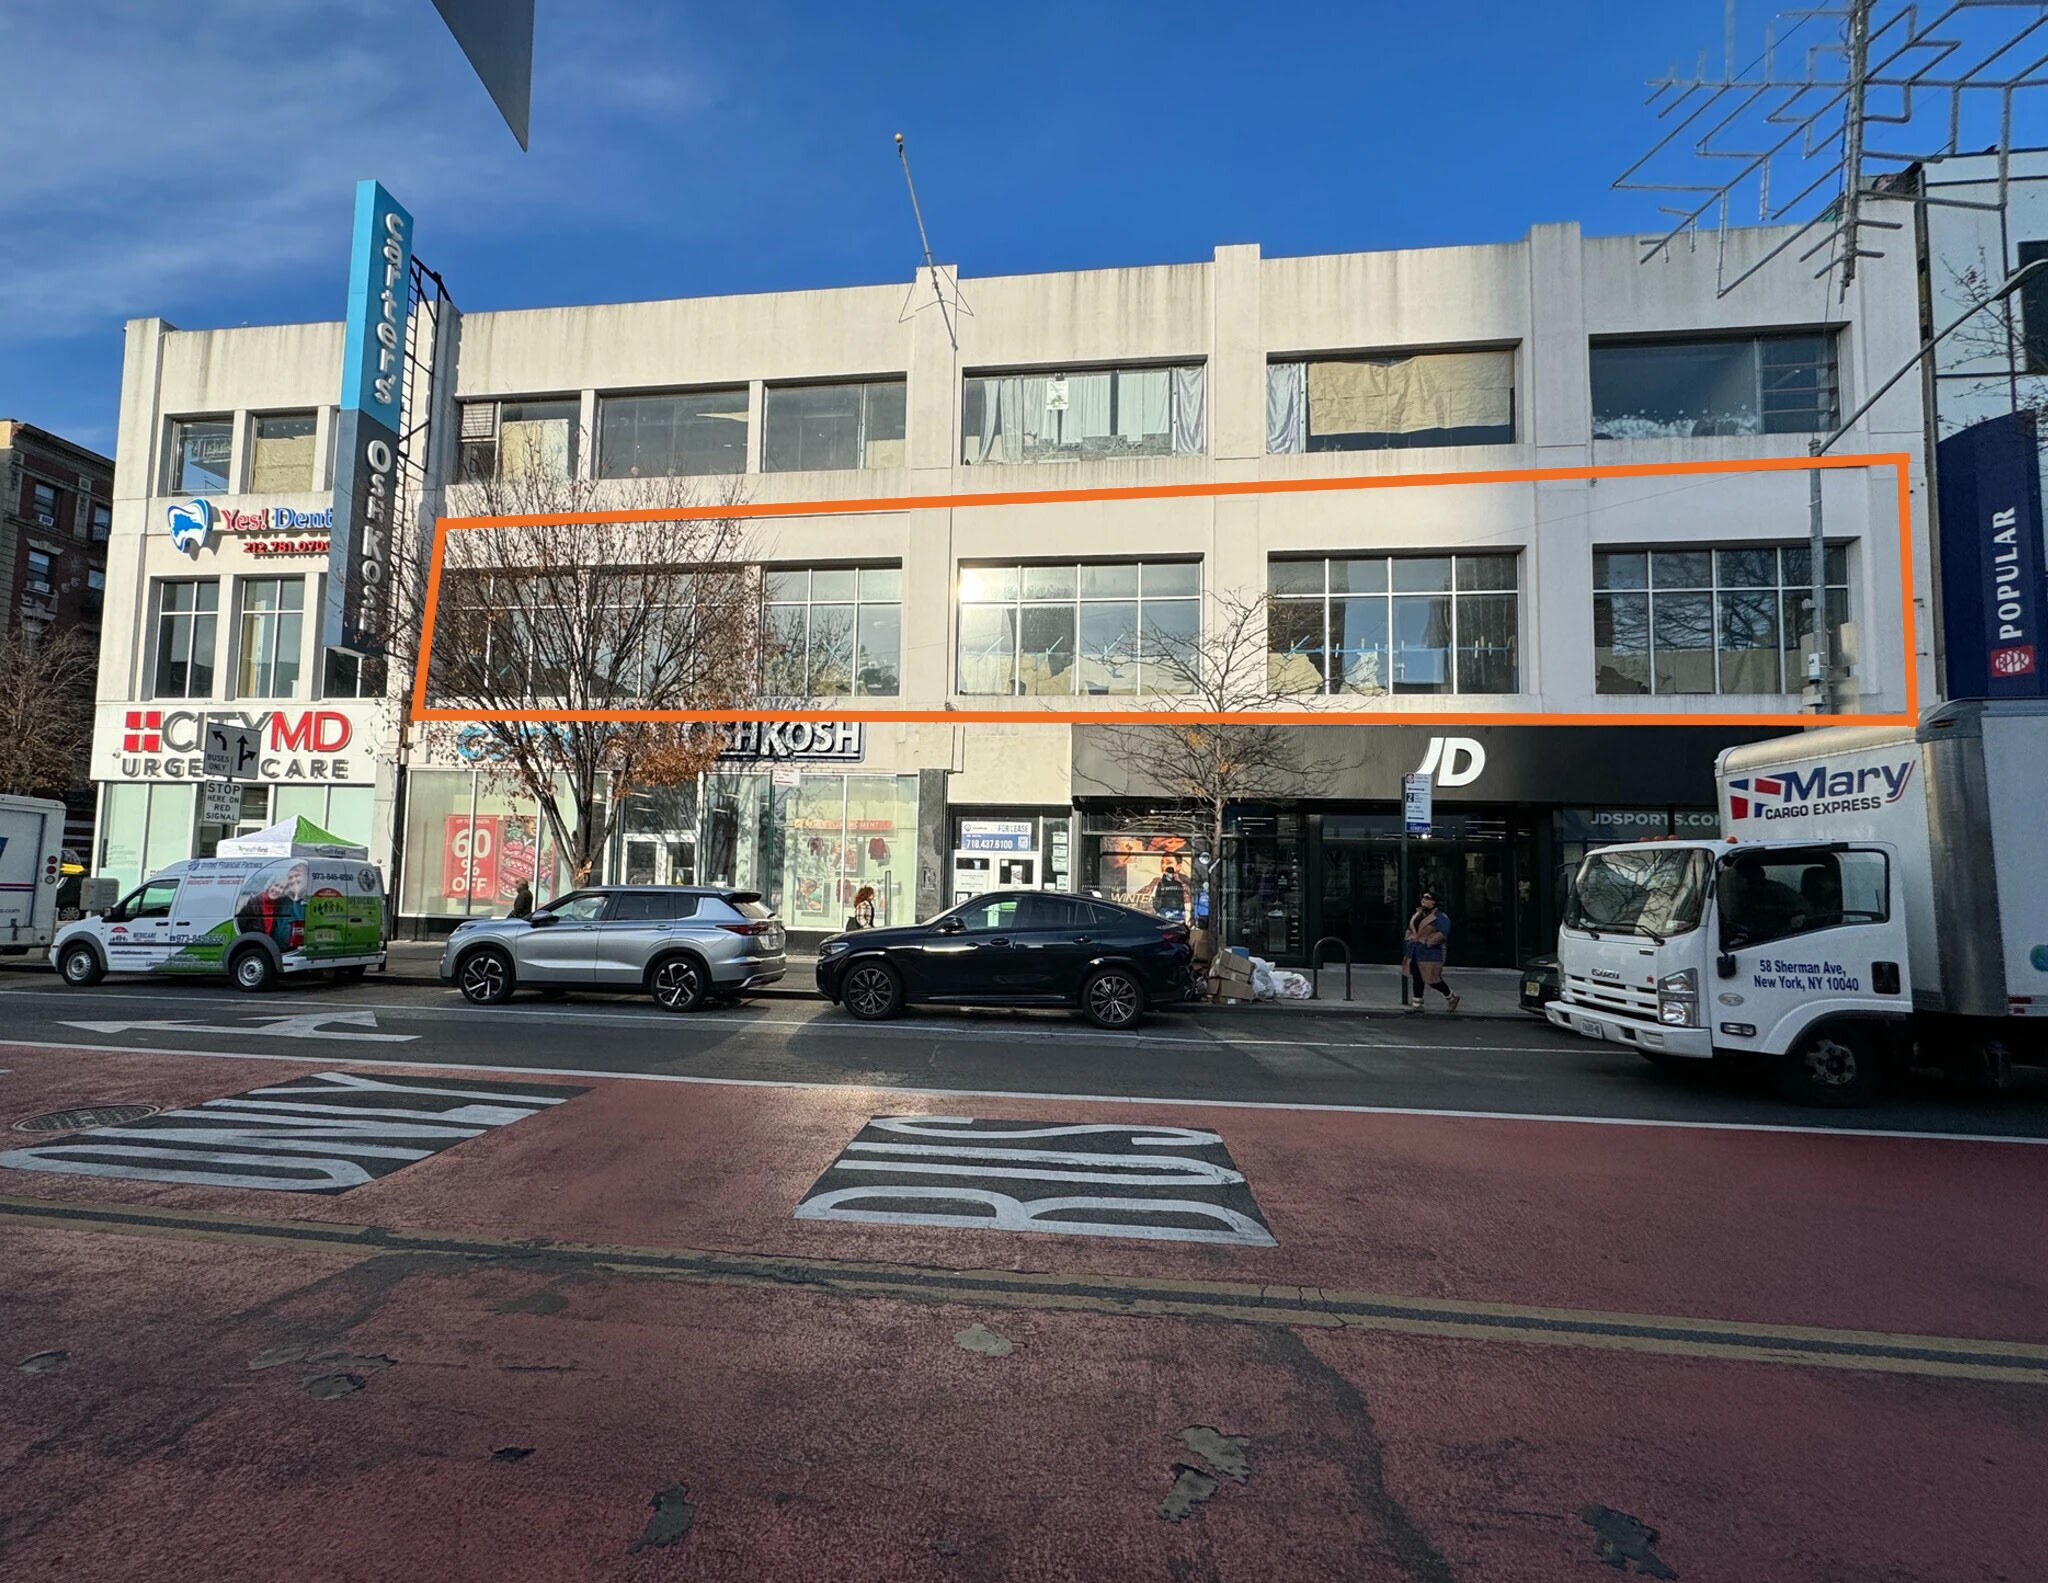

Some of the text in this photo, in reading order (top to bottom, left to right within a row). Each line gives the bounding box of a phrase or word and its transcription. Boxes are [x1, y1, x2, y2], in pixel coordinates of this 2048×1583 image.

[220, 508, 333, 531] Yes! Dent
[1992, 507, 2023, 640] POPULAR
[122, 758, 349, 779] URGE CARE
[207, 754, 229, 763] BUSES
[209, 763, 227, 771] ONLY
[1415, 737, 1486, 787] JD
[207, 783, 240, 795] STOP
[1768, 762, 1912, 803] Mary
[1765, 796, 1882, 820] CARGO EXPRESS
[1011, 824, 1029, 833] LEASE
[452, 828, 491, 858] 60
[452, 876, 487, 892] OFF
[1591, 968, 1620, 980] ISUZU
[1760, 960, 1846, 977] 58 Sherman Ave,
[1754, 975, 1859, 991] New York, NY 10040
[0, 1071, 569, 1190] ONLY
[793, 1115, 1280, 1248] BUS
